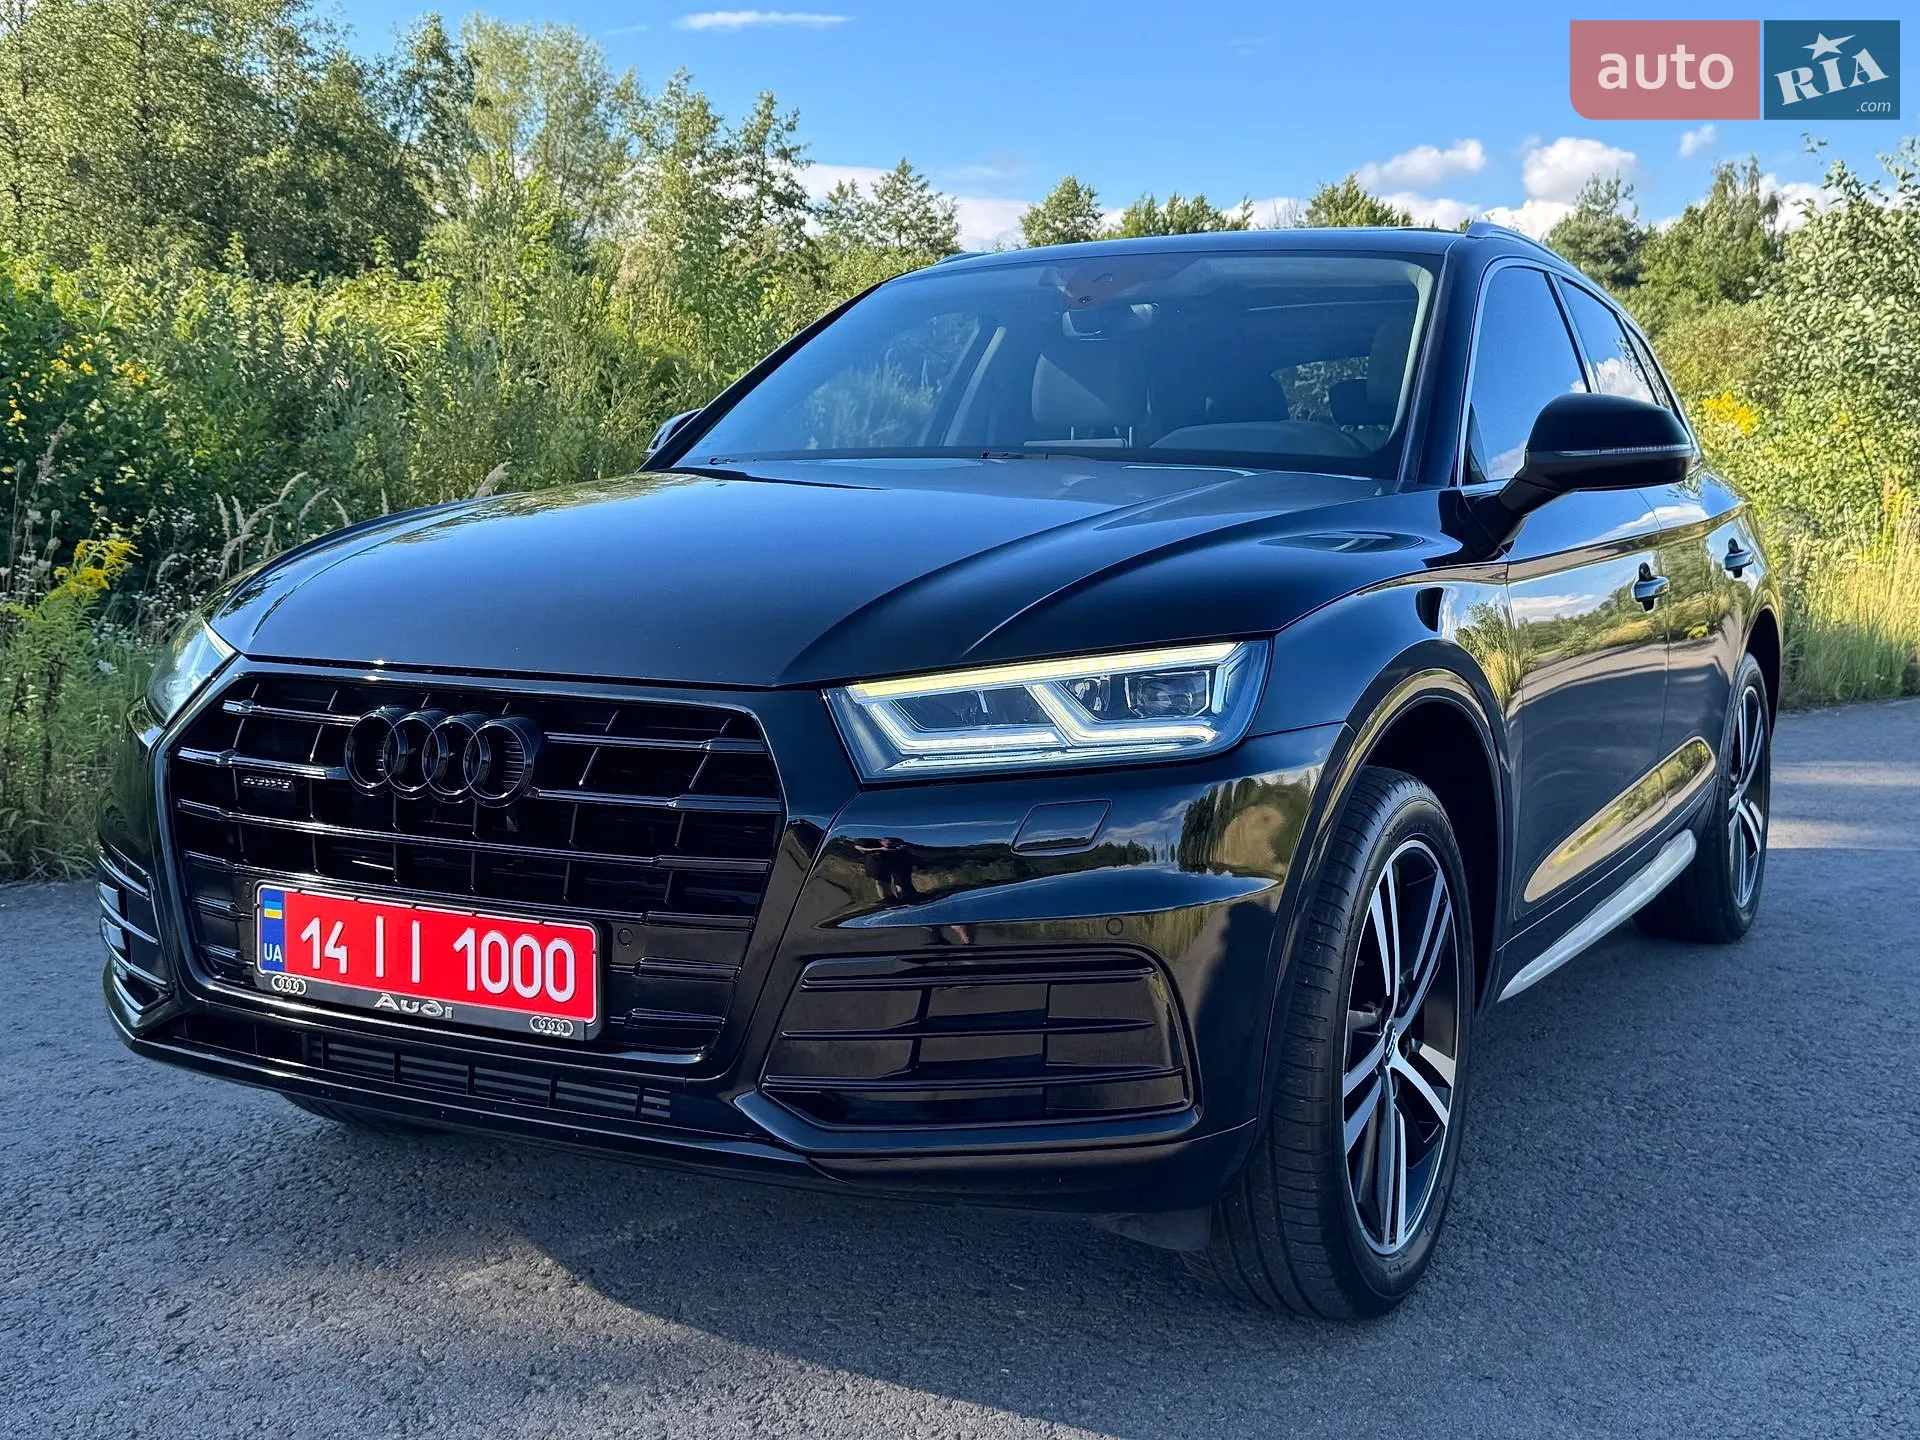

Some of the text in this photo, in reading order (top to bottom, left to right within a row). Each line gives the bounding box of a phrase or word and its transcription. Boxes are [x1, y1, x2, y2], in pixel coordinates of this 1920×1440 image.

[264, 942, 283, 962] UA
[300, 917, 348, 974] 14
[452, 927, 575, 1003] 1000
[374, 993, 453, 1019] Audi
